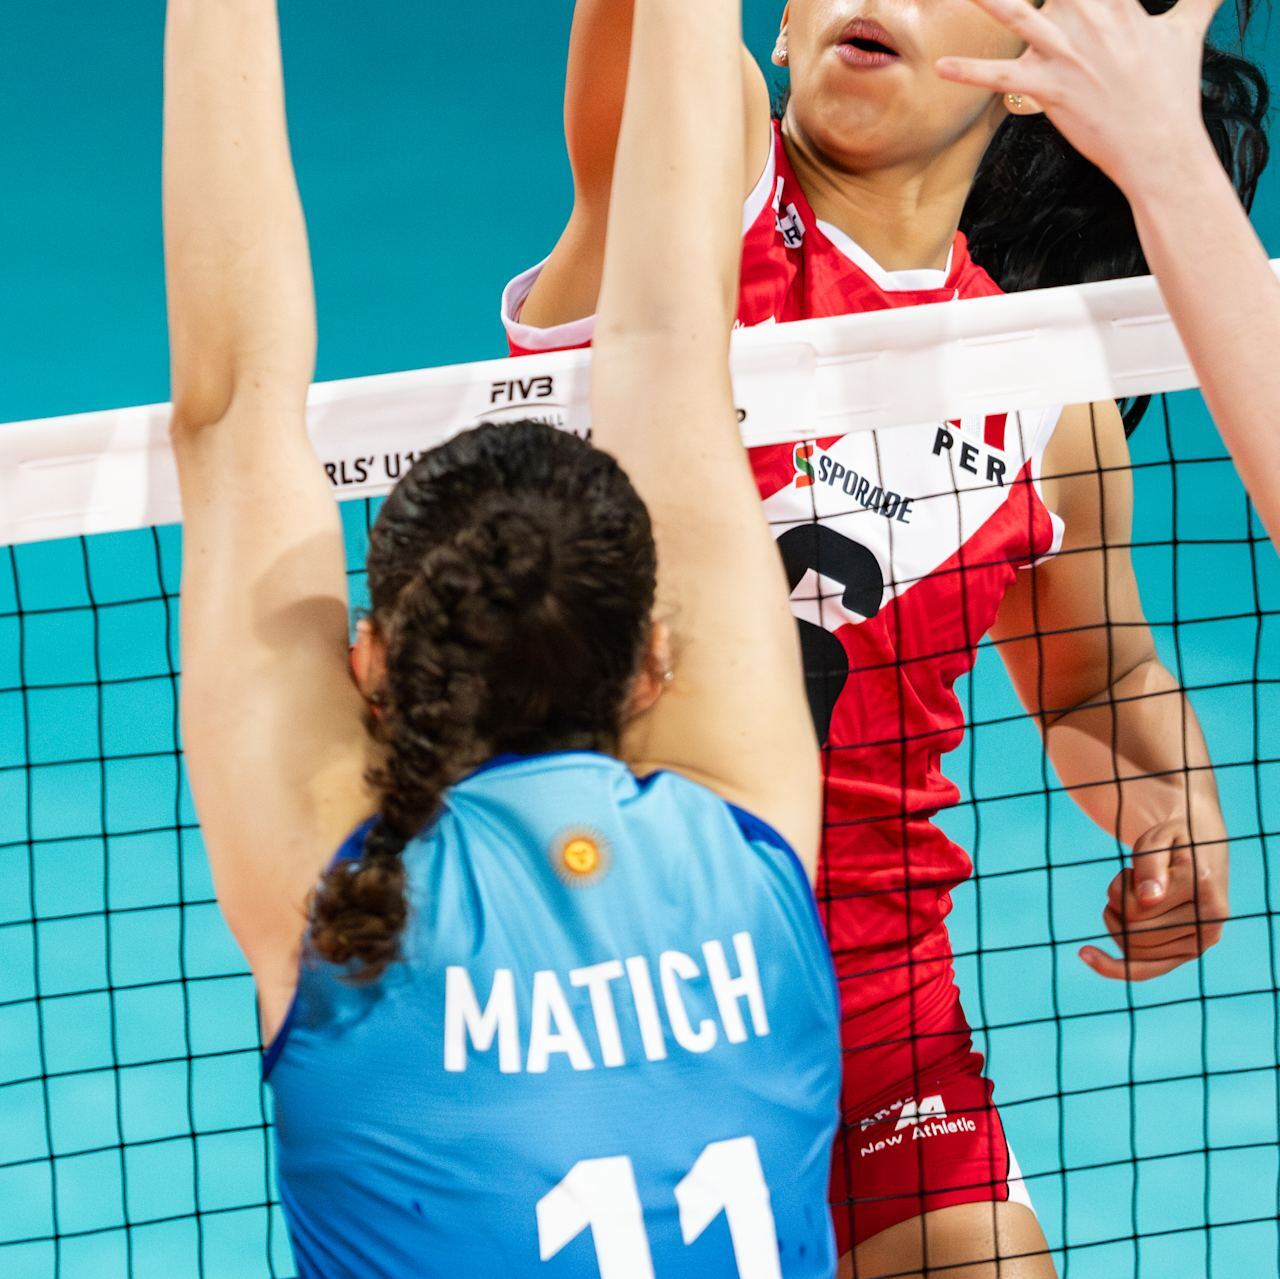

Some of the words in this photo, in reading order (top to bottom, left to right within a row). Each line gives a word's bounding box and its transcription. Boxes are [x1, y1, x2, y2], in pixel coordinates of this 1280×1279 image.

[490, 375, 554, 403] FIVB
[932, 426, 1007, 487] PER
[818, 454, 915, 525] SPORADE
[443, 930, 771, 1074] MATICH
[860, 1133, 903, 1158] New
[911, 1116, 977, 1141] Athletic
